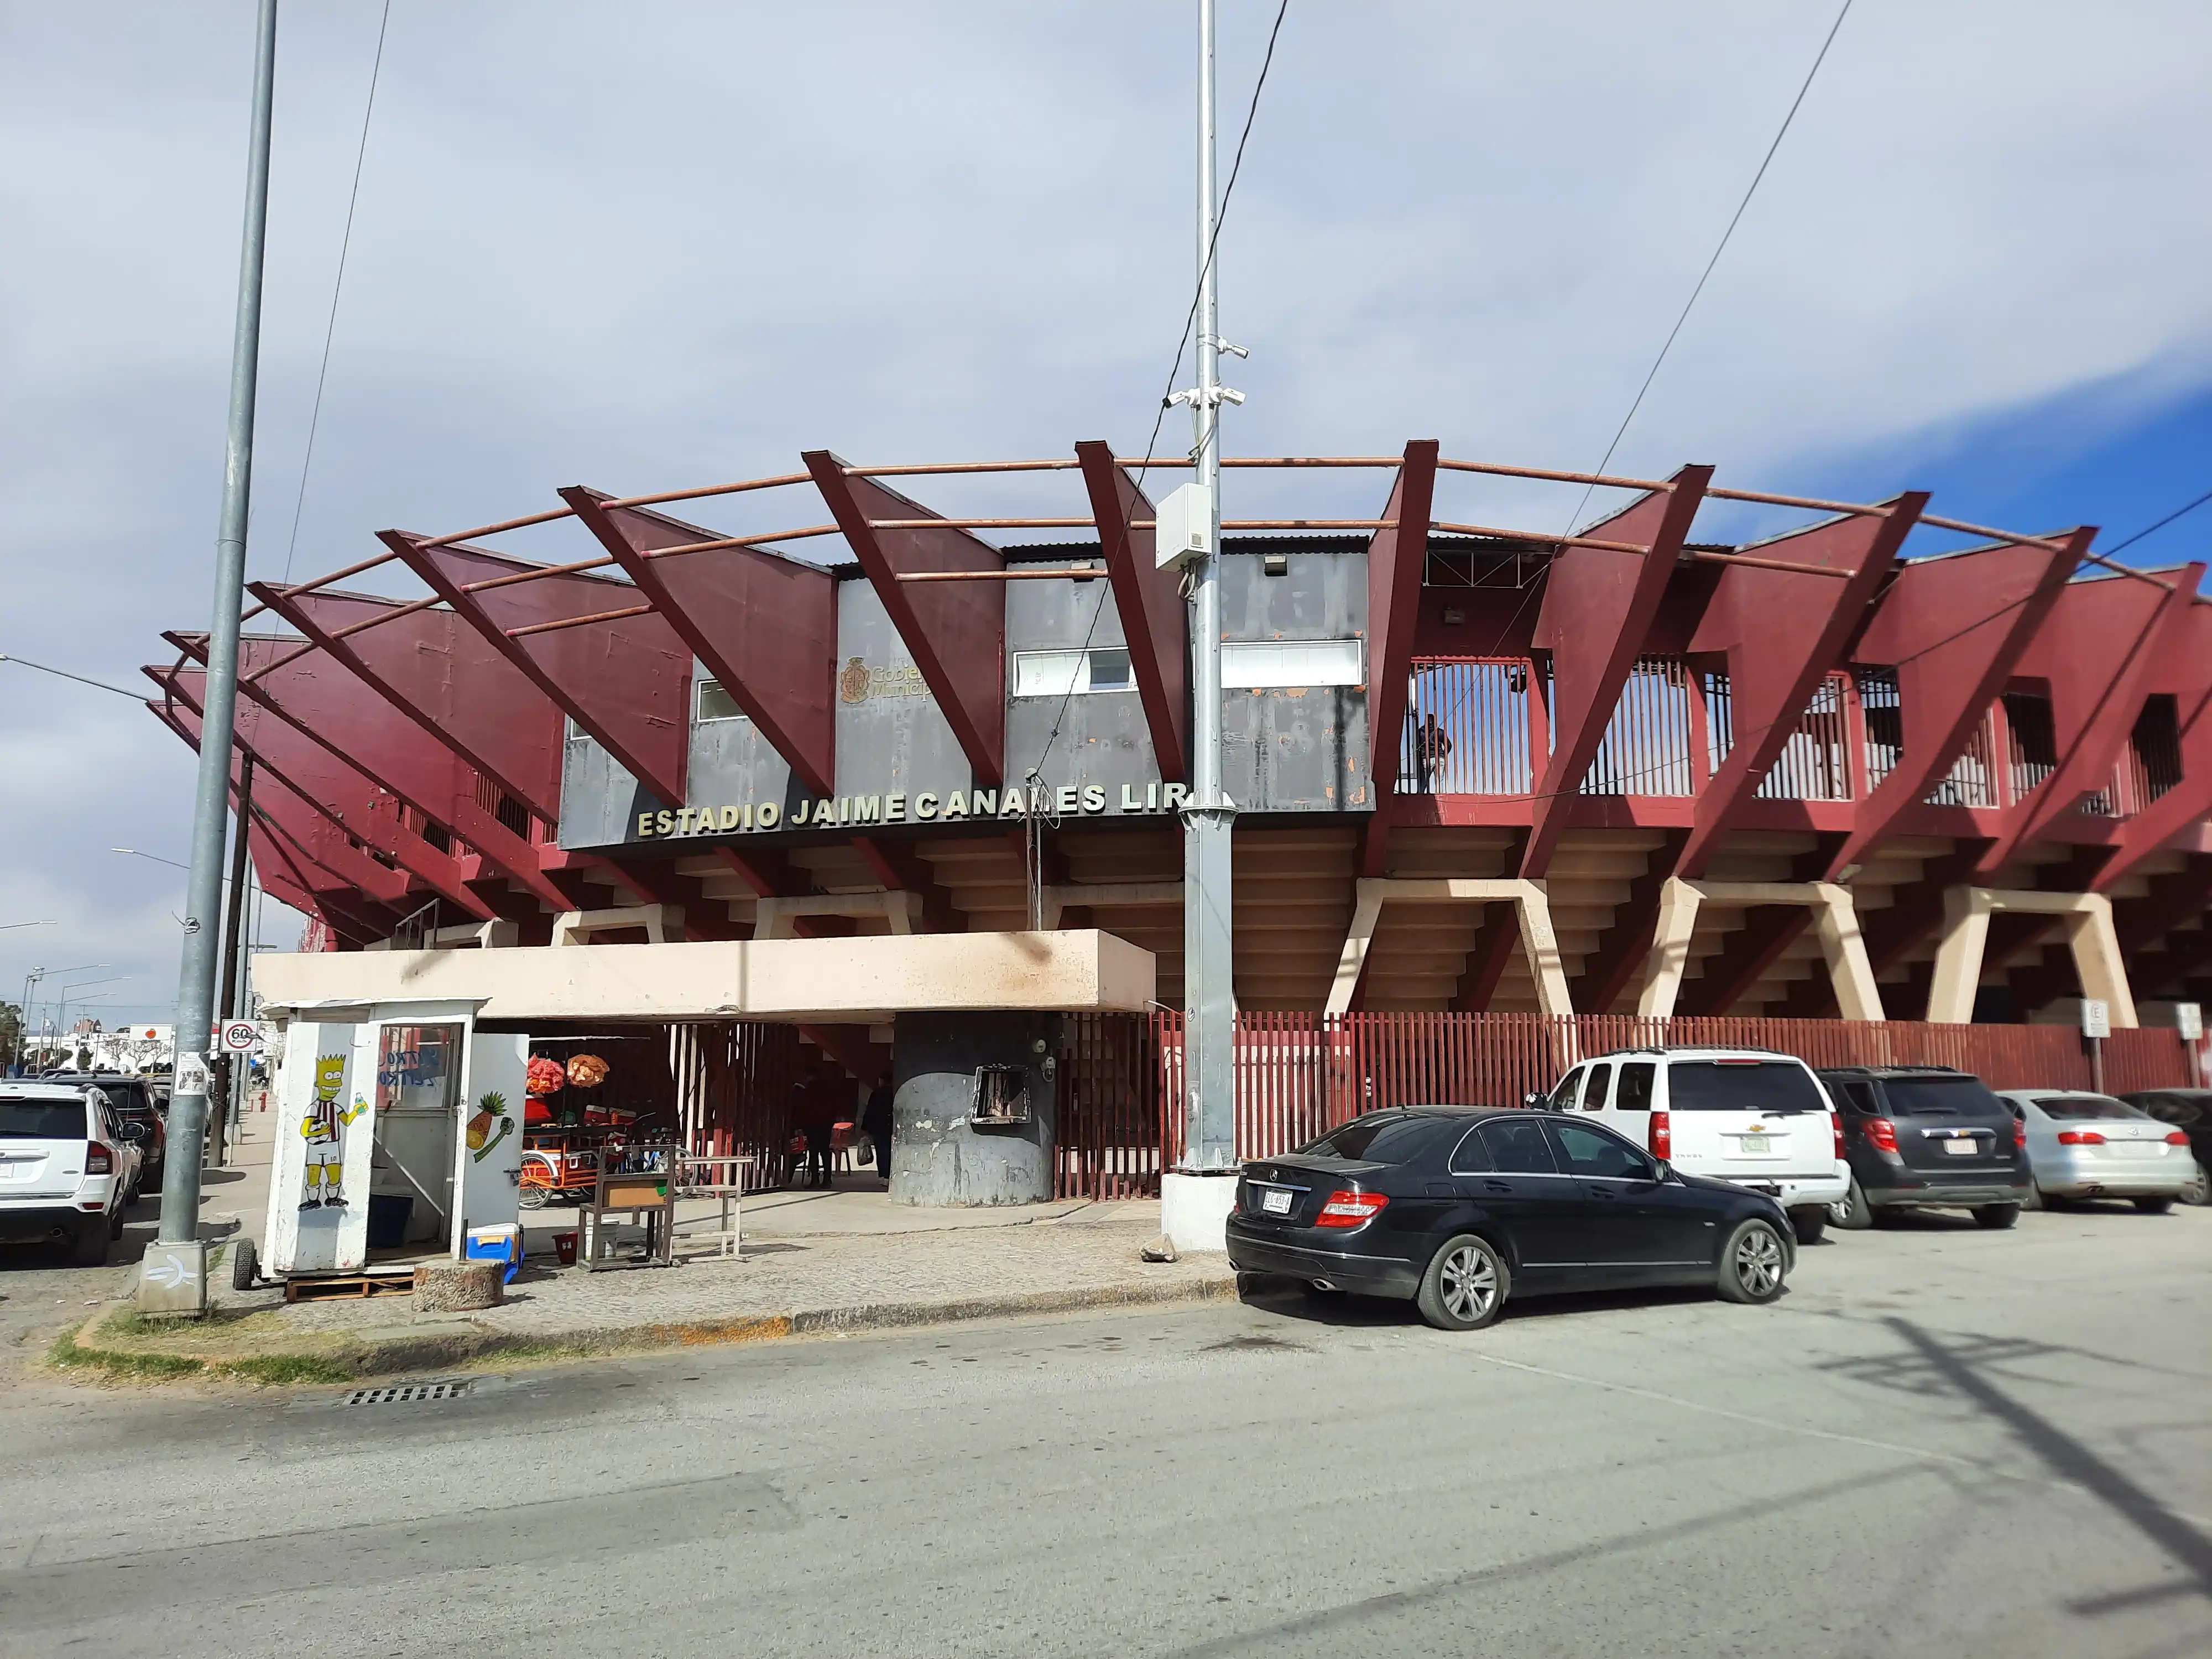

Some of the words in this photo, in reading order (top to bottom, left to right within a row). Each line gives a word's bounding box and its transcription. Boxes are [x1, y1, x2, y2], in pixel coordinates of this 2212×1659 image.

[870, 680, 931, 702] Municip
[638, 801, 780, 836] ESTADIO
[791, 794, 906, 824] JAIME
[1121, 782, 1188, 809] LIR
[232, 1029, 249, 1039] 60
